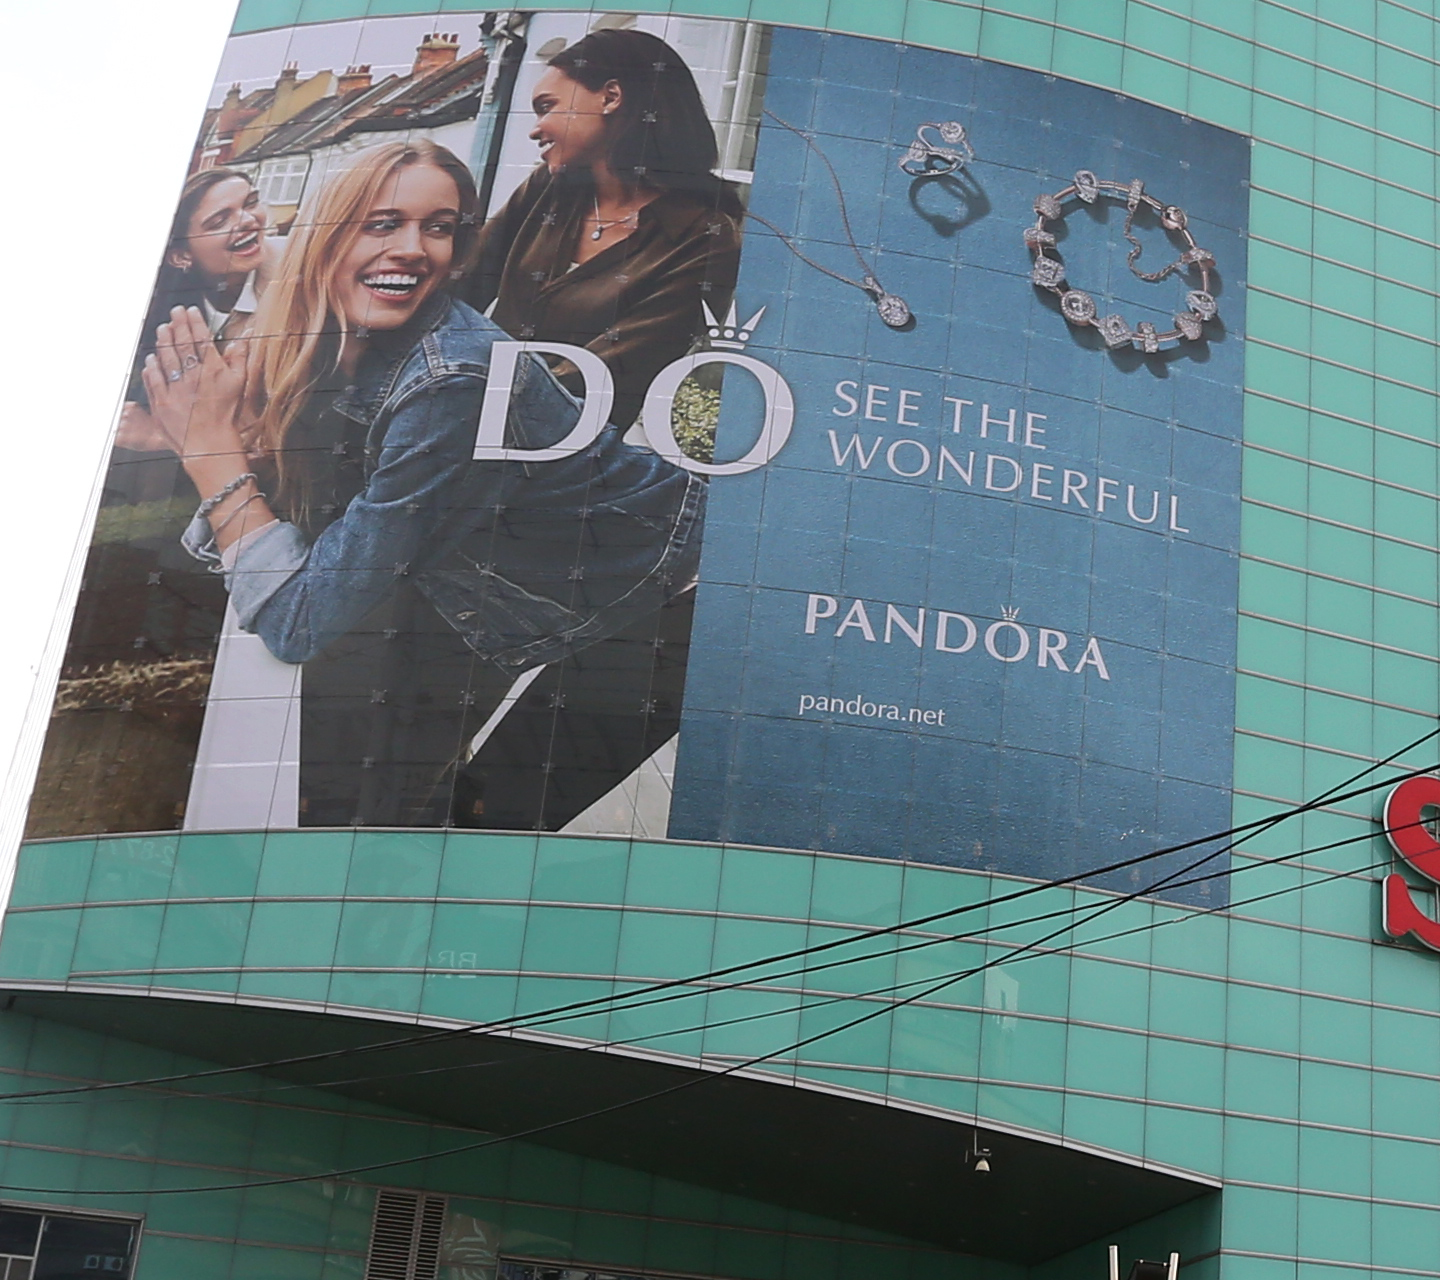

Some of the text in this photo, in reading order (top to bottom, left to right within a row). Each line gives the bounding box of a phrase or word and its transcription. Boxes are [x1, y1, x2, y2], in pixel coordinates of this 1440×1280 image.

[831, 378, 1049, 450] SEE THE
[828, 427, 1192, 536] WONDERFUL
[803, 592, 1112, 682] PANDORA
[798, 690, 946, 729] pandora.net
